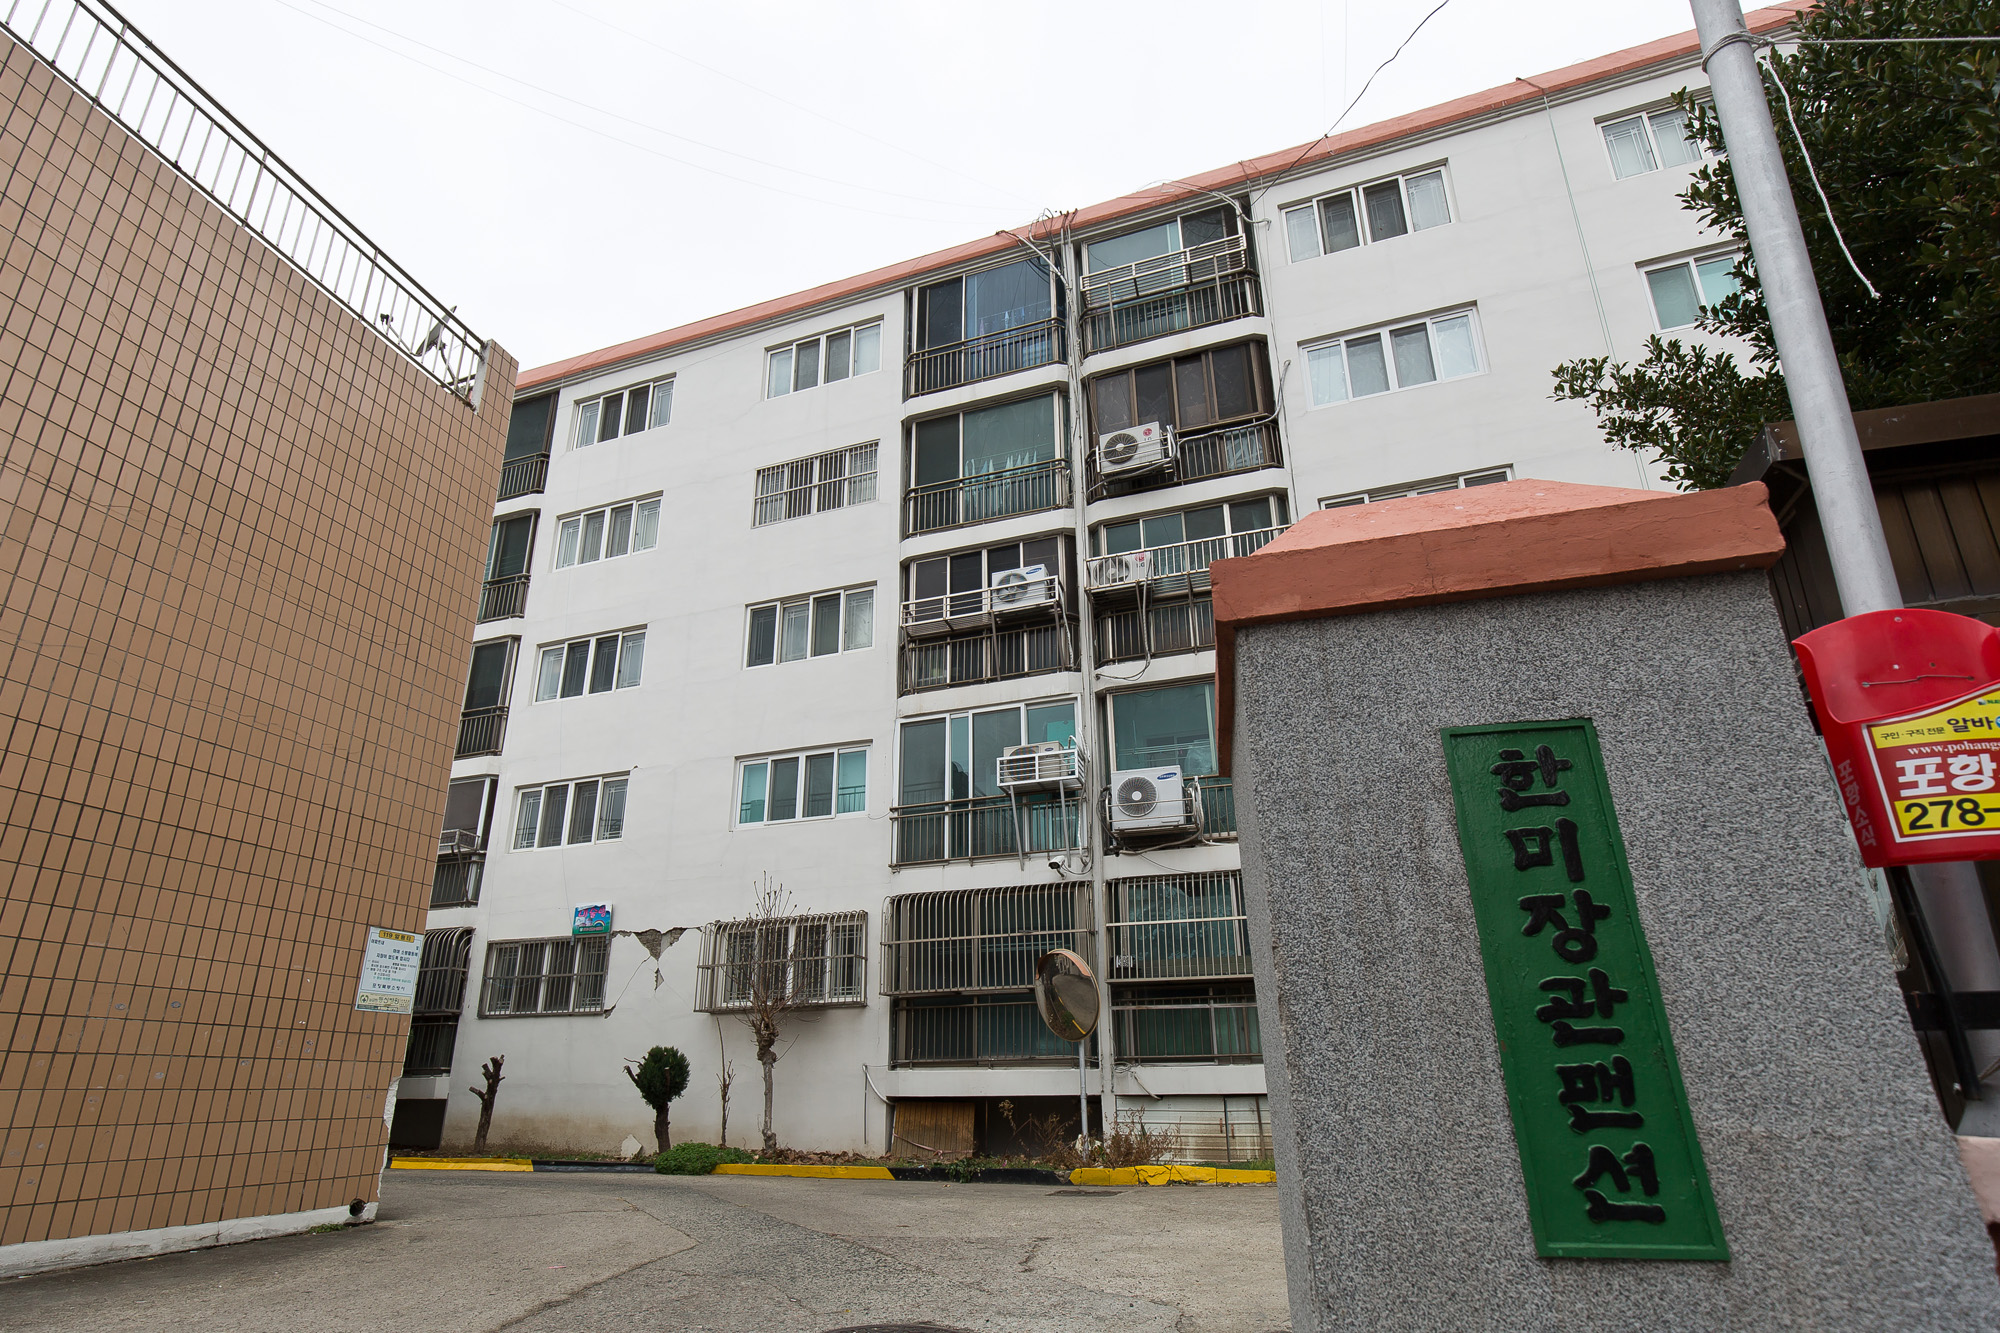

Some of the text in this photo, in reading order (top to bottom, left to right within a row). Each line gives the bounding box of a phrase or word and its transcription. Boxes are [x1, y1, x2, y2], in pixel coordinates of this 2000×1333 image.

[1927, 726, 1945, 735] 전문
[1895, 753, 1997, 797] 포항
[1838, 759, 1877, 846] 포항소식
